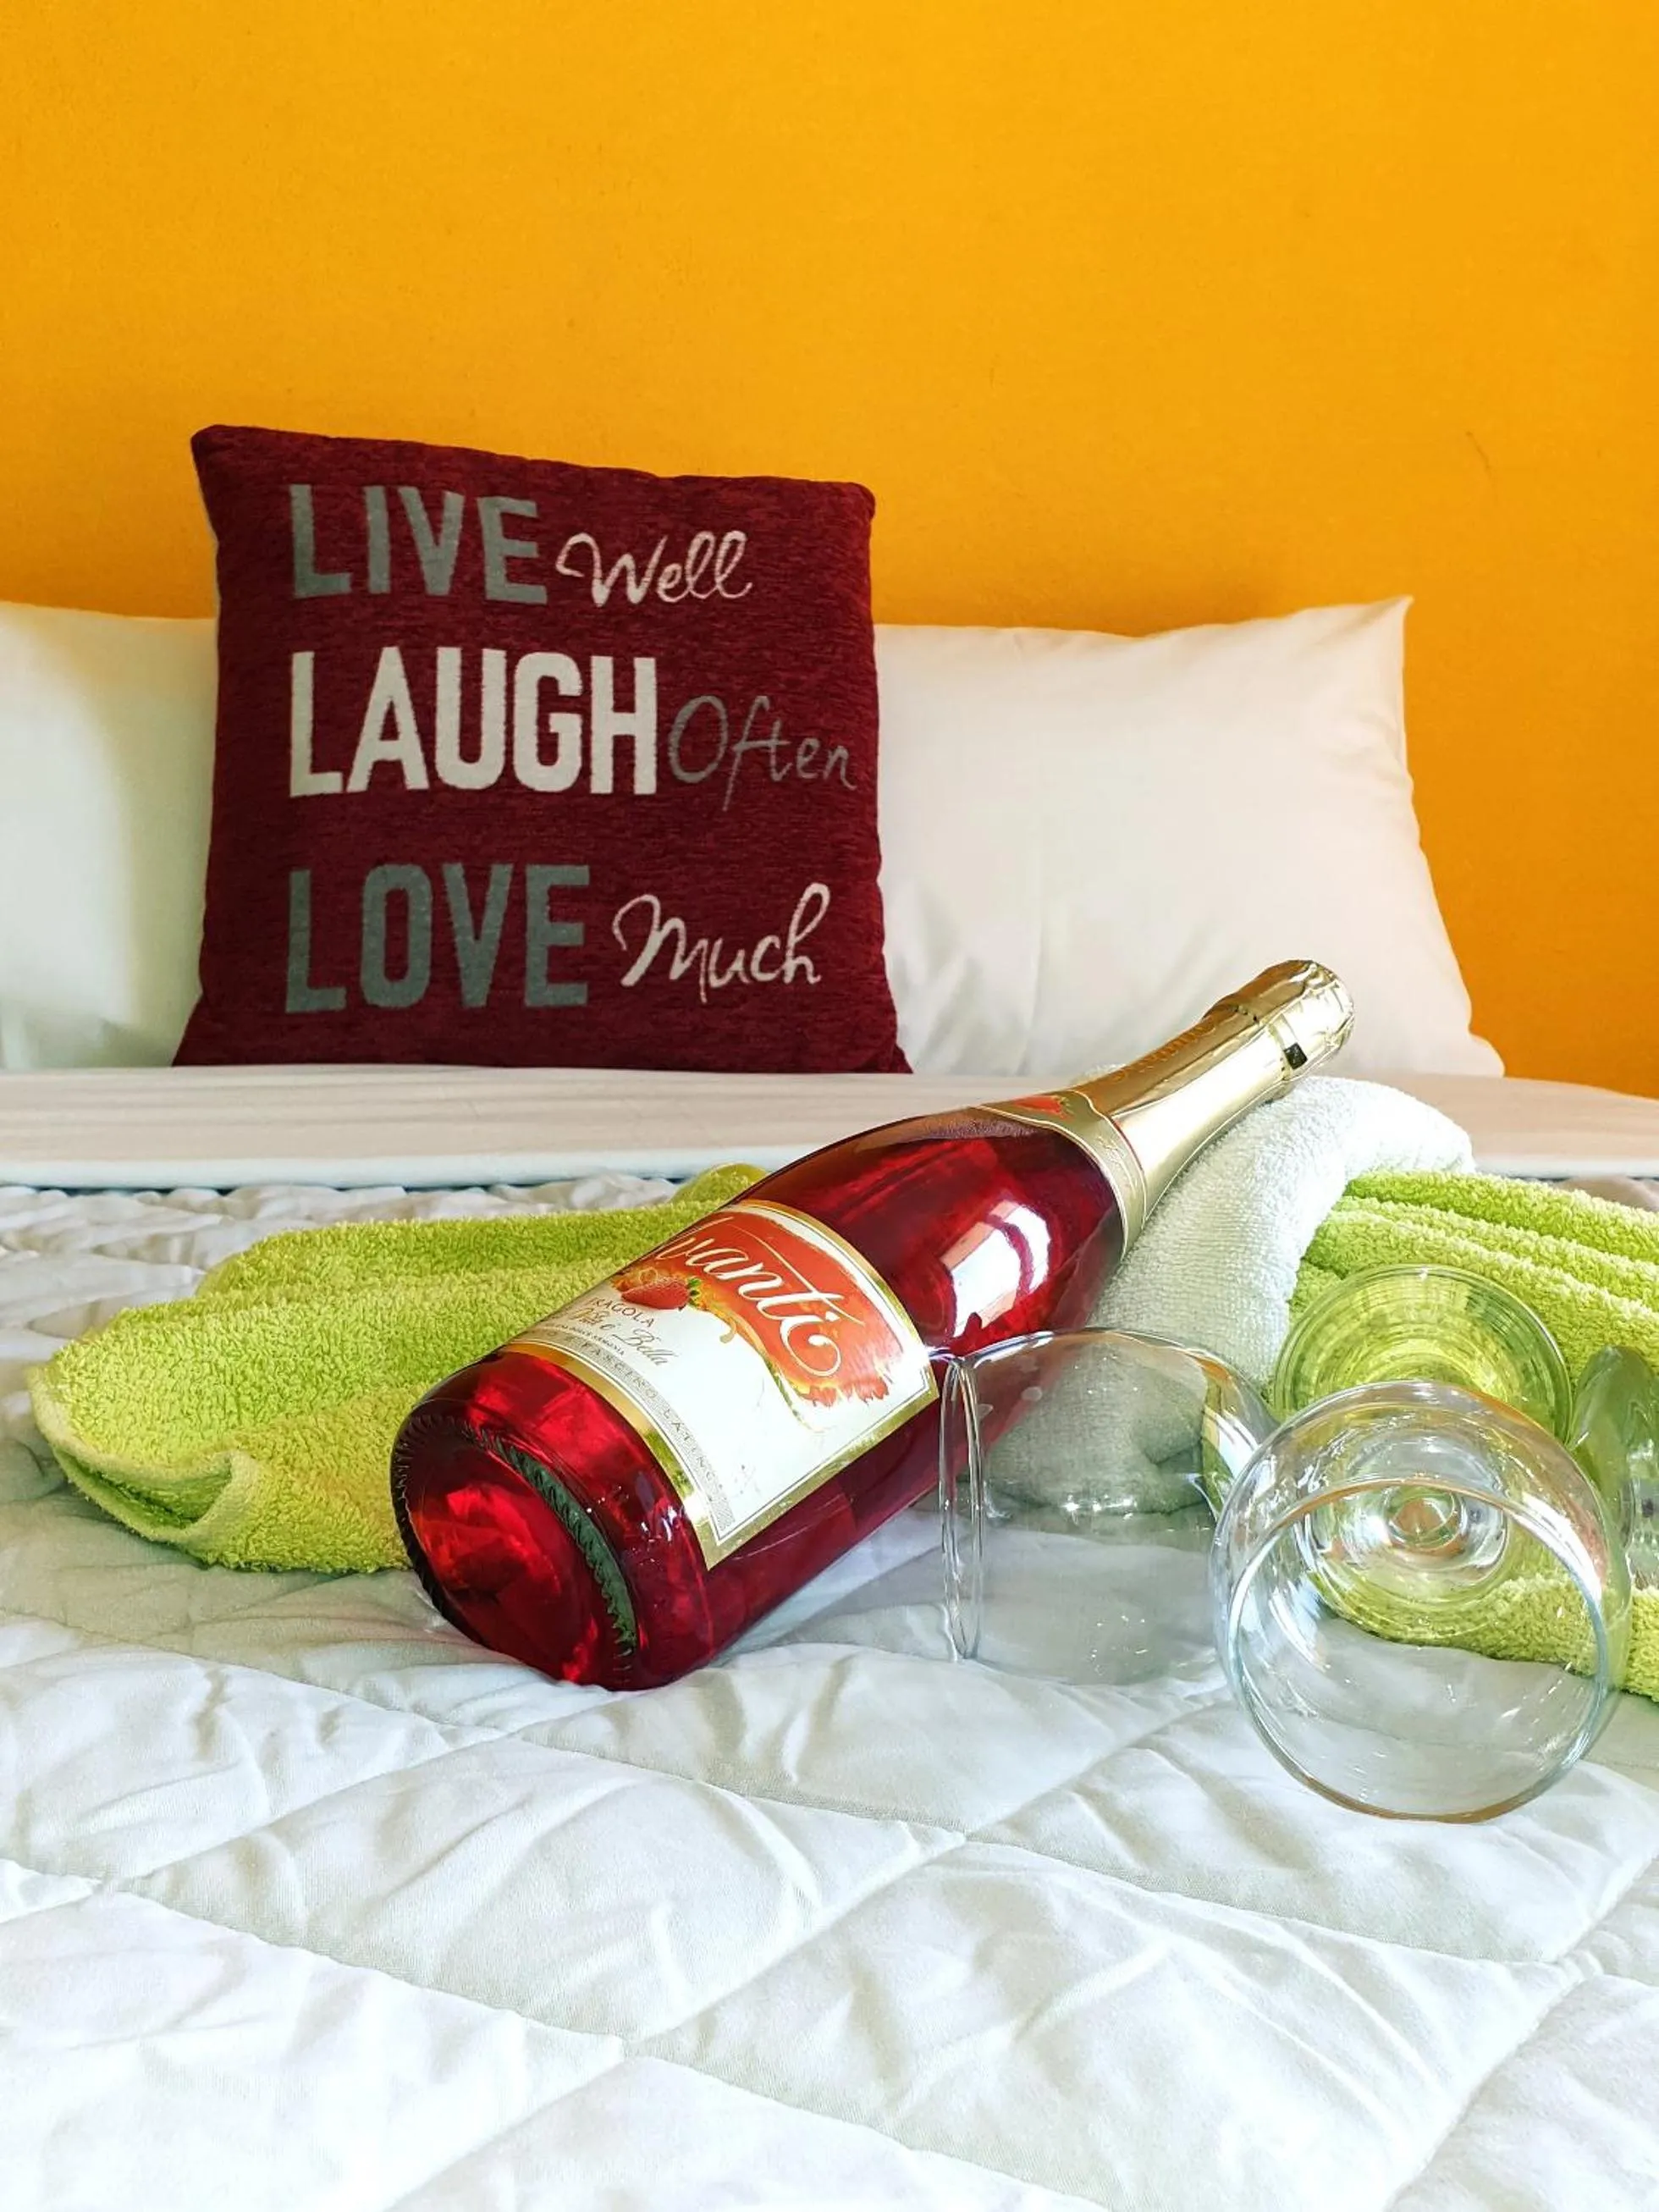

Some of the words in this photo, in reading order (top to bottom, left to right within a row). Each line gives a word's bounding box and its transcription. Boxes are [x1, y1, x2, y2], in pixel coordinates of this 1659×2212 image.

[290, 483, 548, 604] LIVE
[555, 532, 753, 606] Well
[289, 646, 658, 798] LAUGH
[667, 696, 857, 812] Often
[285, 863, 590, 1014] LOVE
[614, 882, 831, 1003] Much
